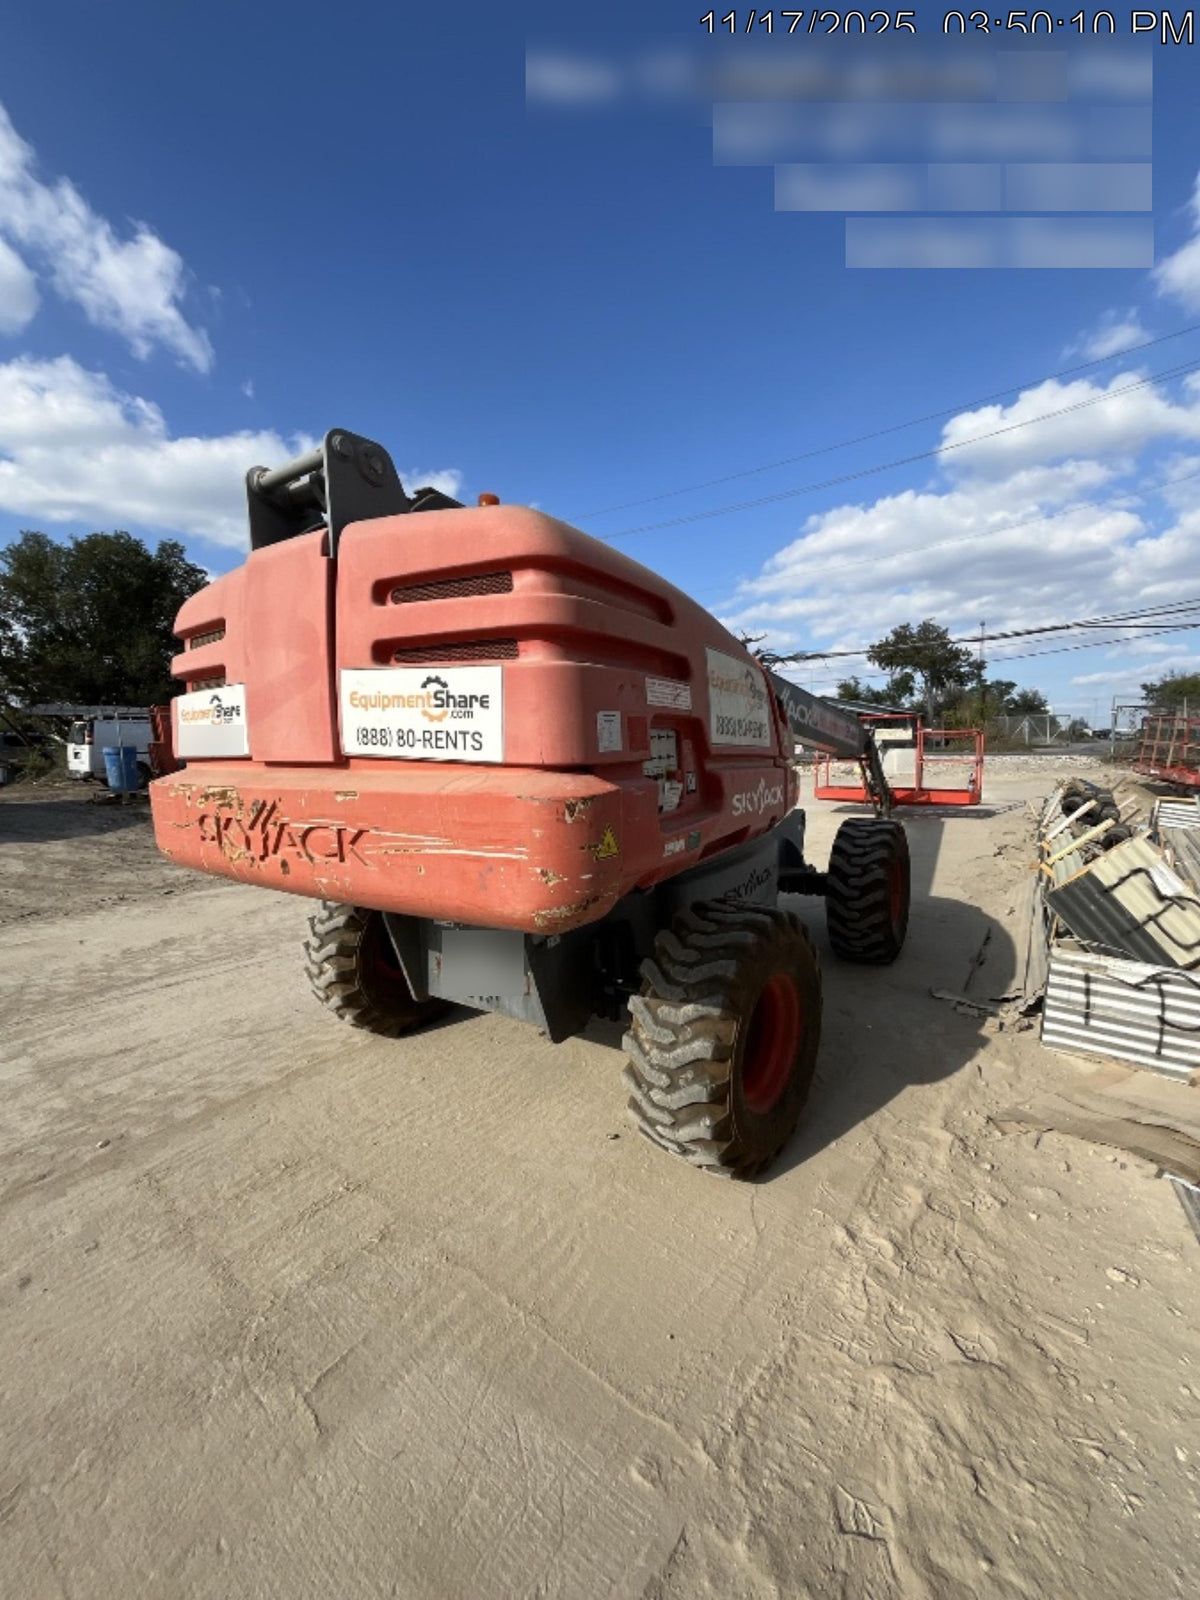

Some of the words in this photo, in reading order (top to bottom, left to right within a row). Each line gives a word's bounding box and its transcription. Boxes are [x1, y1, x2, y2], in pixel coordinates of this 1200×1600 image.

[349, 689, 490, 711] EquipmentShare
[356, 727, 393, 747] (888)
[397, 728, 484, 751] 80-RENTS
